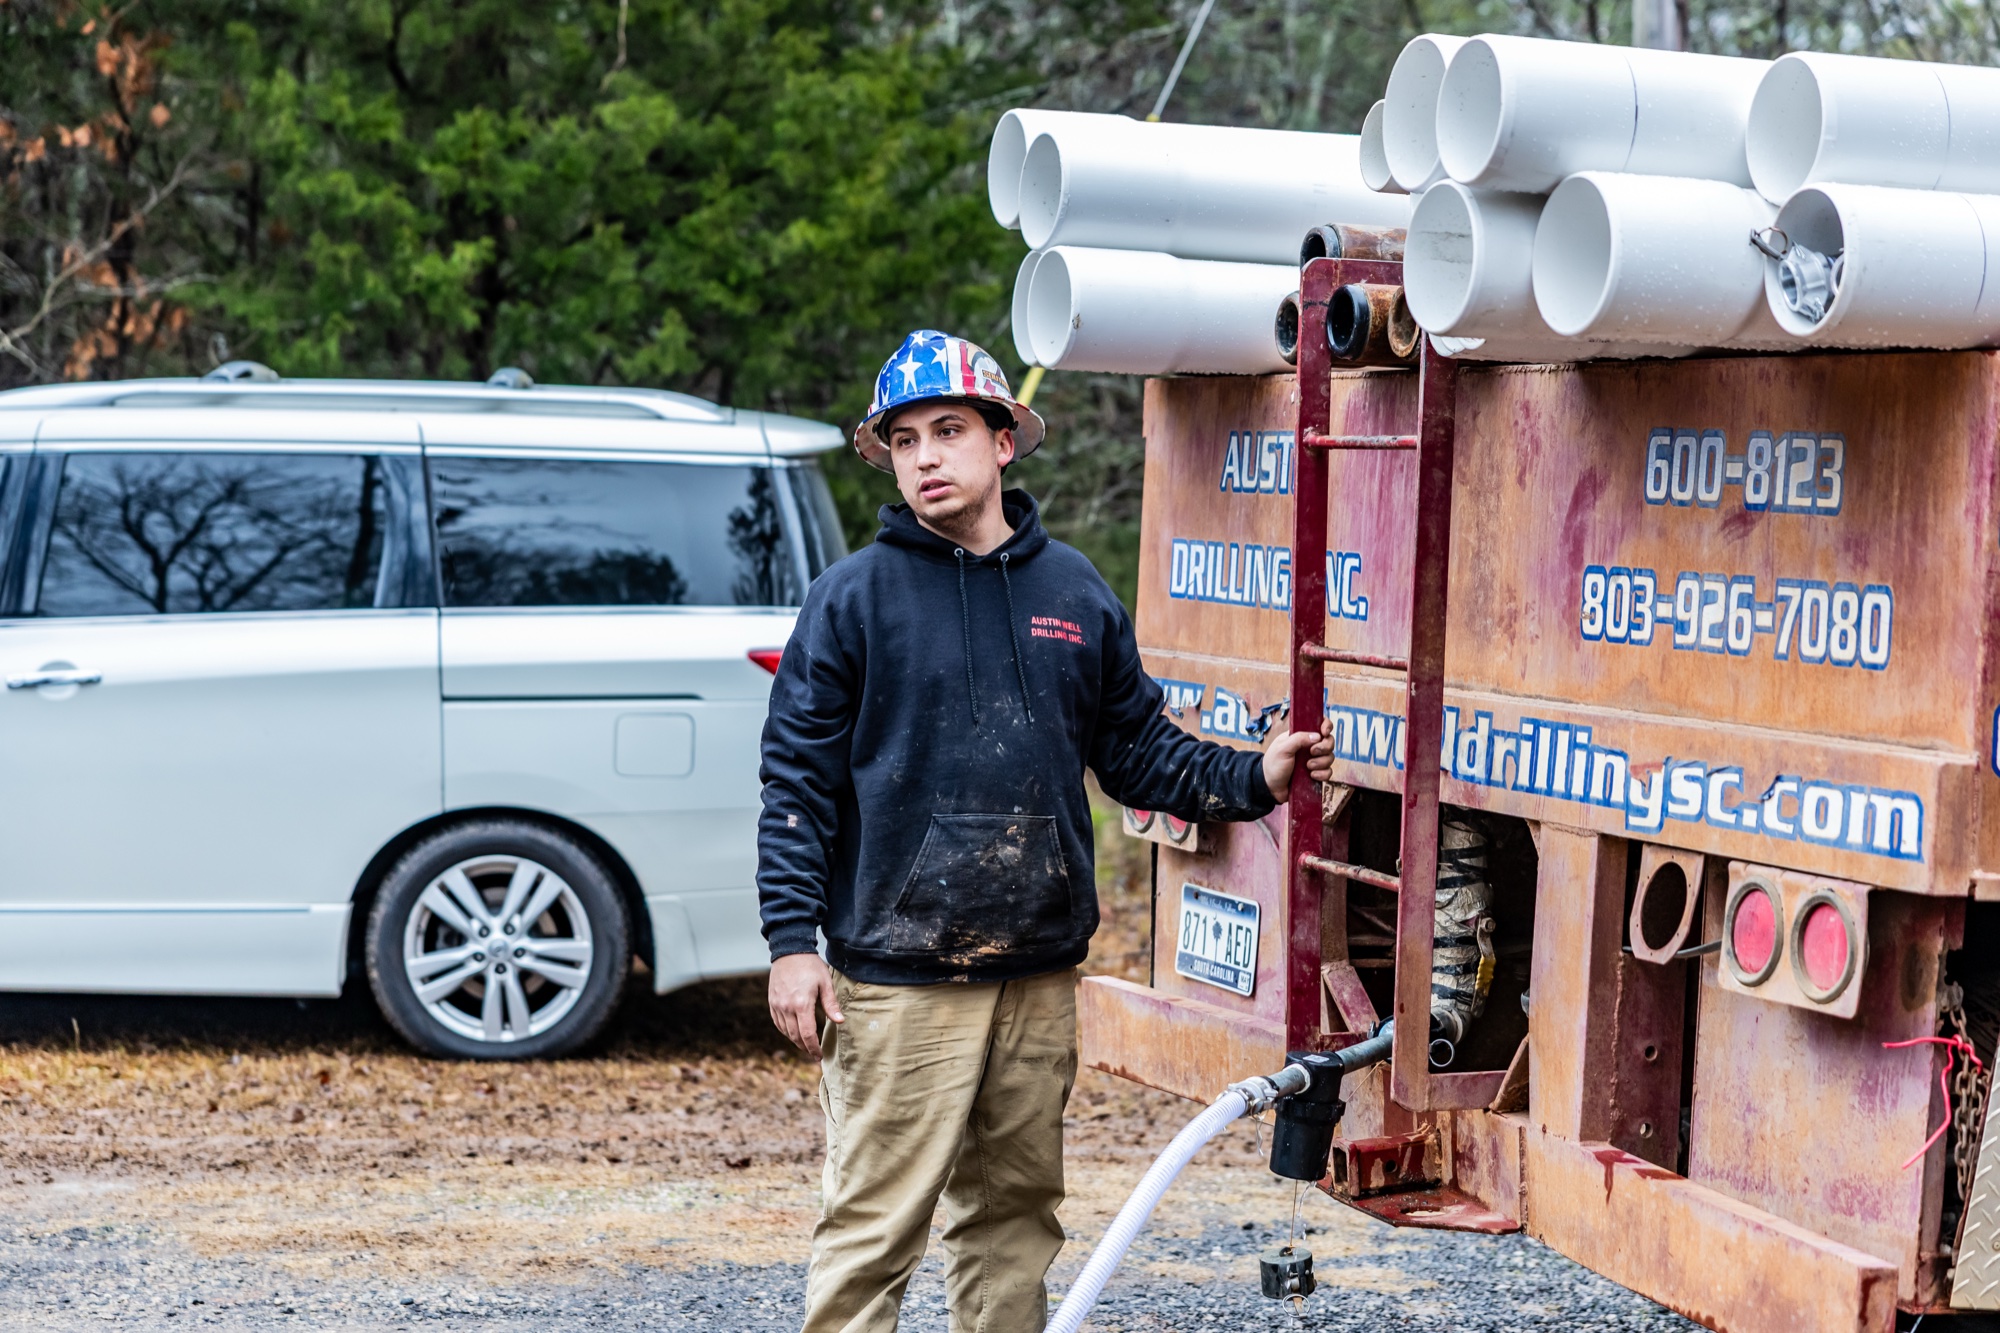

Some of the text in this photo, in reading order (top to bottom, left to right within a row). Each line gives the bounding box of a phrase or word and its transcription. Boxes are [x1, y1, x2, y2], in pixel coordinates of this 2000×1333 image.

[1220, 431, 1296, 495] AUST
[1643, 427, 1847, 516] 600-8123
[1170, 538, 1369, 621] DRILLING NC.
[1031, 616, 1082, 633] AUSTIN WELL
[1031, 627, 1086, 646] DRILLING INC.
[1580, 565, 1894, 671] 803-926-7080
[1183, 910, 1252, 968] 871 AED
[1193, 959, 1234, 983] SOUTH CAROLINA
